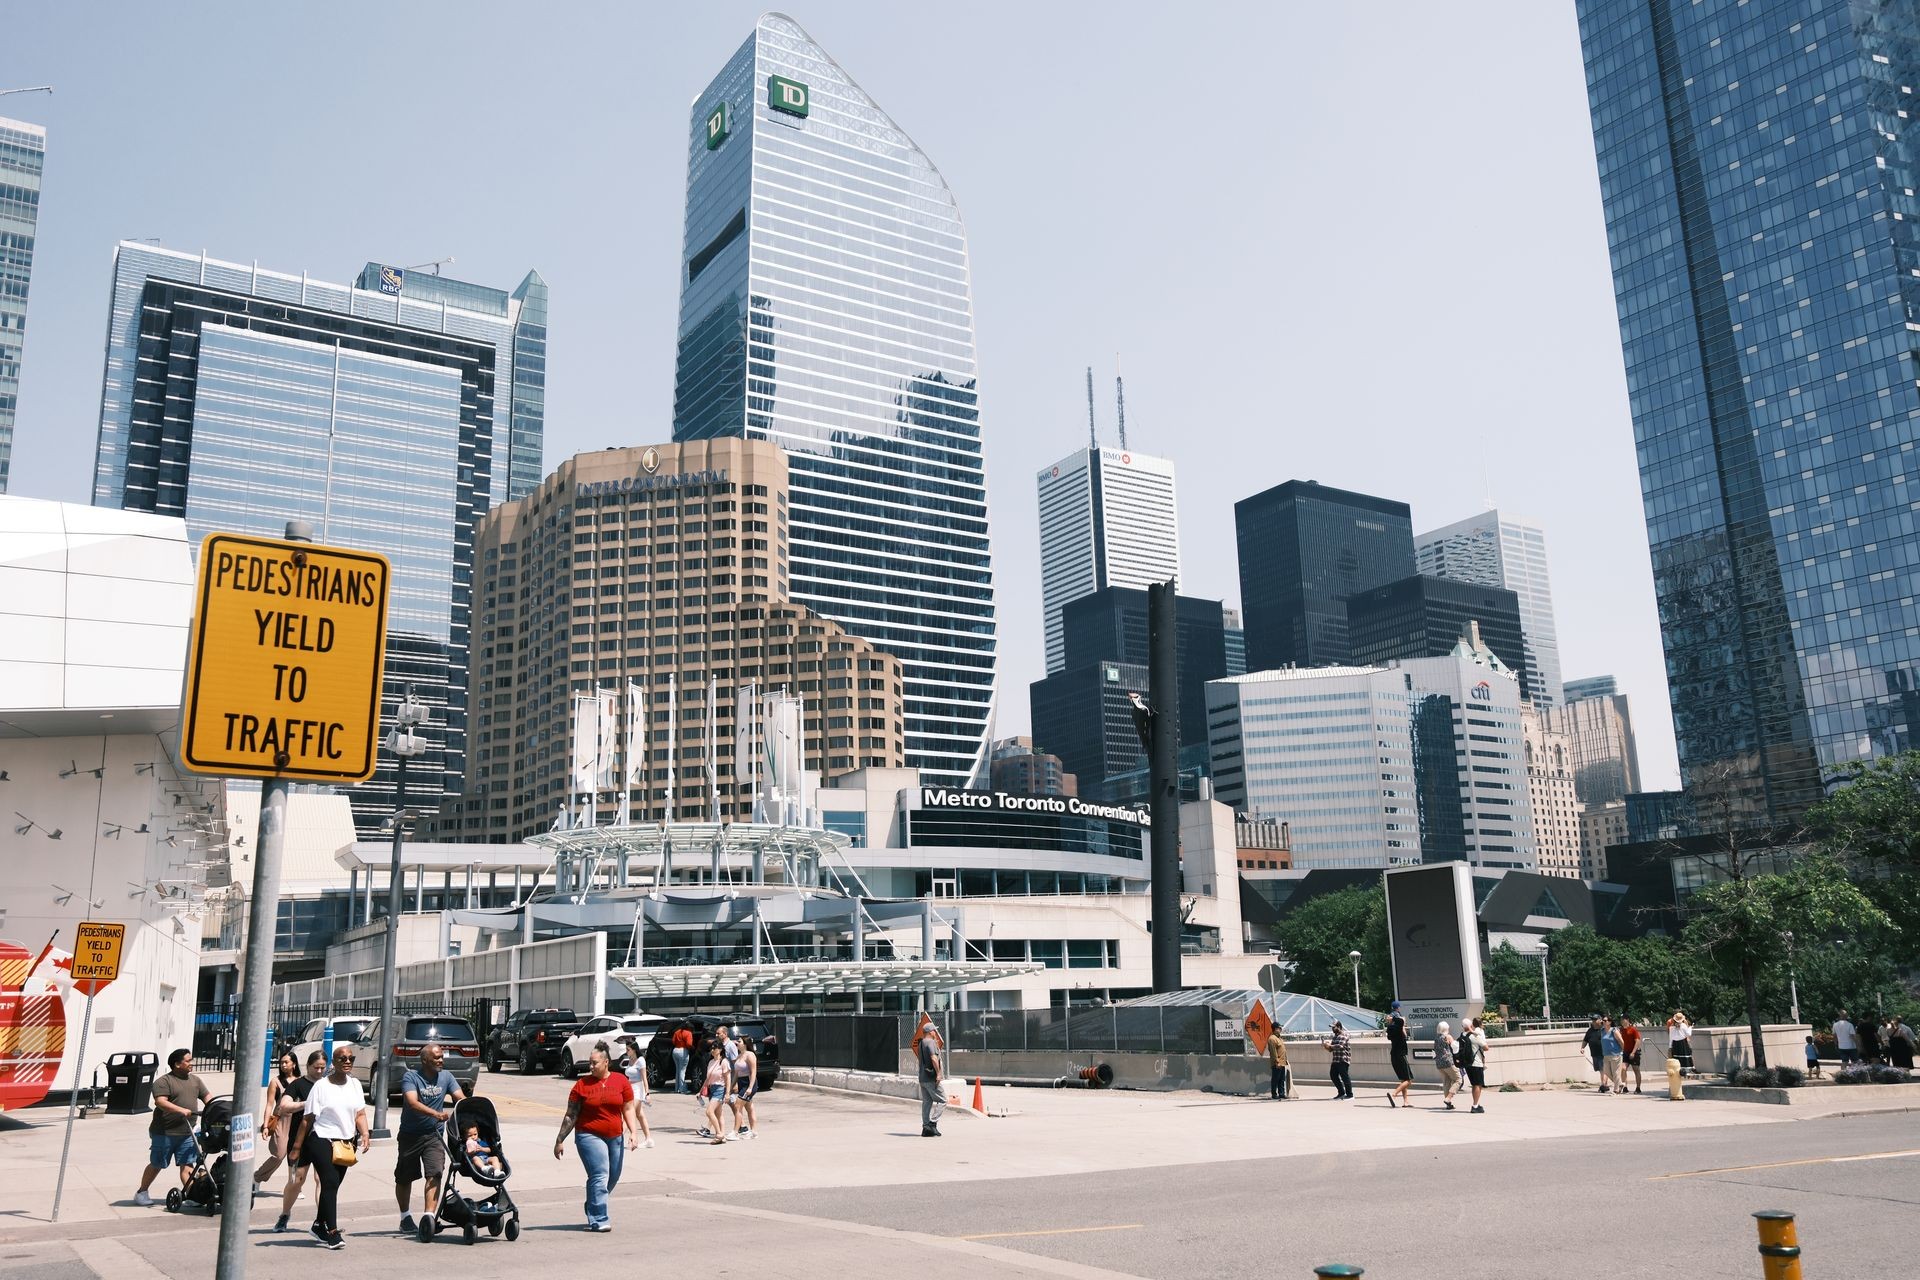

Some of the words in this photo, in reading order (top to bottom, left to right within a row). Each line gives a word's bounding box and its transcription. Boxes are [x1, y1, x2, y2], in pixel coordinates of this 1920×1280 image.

[777, 81, 805, 107] TD
[708, 111, 721, 138] TD
[382, 284, 399, 293] RBC
[1103, 451, 1121, 462] BMO
[576, 469, 728, 497] INTERCONTINENTAL
[1038, 471, 1052, 483] BMO
[216, 552, 376, 607] PEDESTRIANS
[254, 609, 335, 653] YIELD
[273, 664, 307, 703] TO
[224, 713, 344, 759] TRAFFIC
[924, 789, 992, 808] Metro
[995, 792, 1066, 812] Toronto
[1068, 798, 1138, 822] Convention
[80, 927, 121, 938] PEDESTRIANS
[87, 940, 111, 950] YIELD
[92, 953, 103, 962] TO
[77, 965, 113, 975] TRAFFIC
[233, 1115, 252, 1131] JESUS
